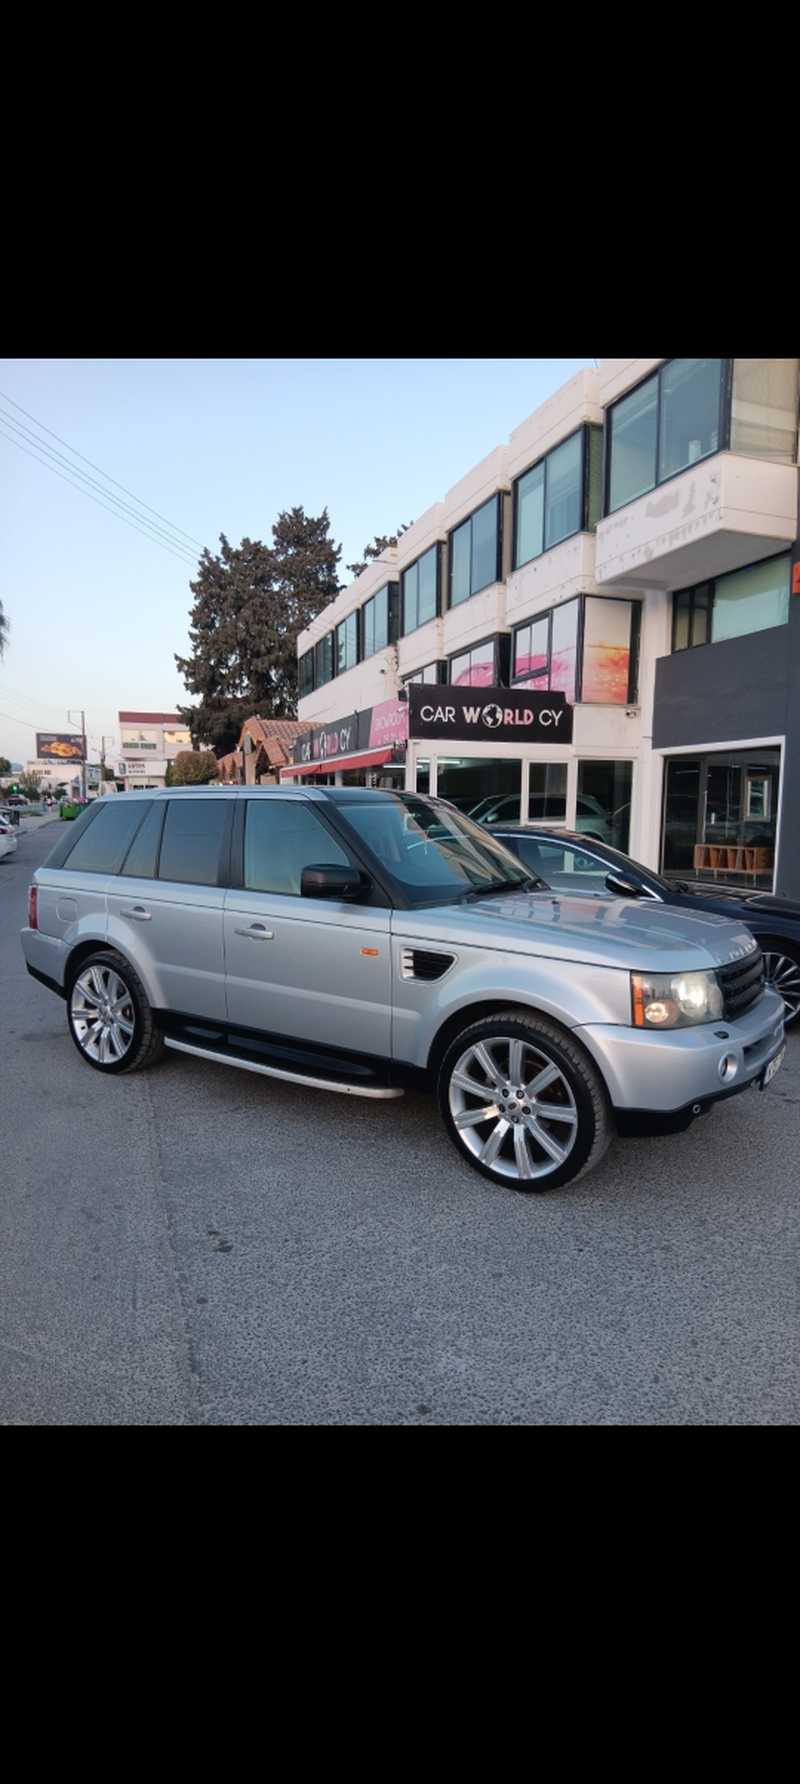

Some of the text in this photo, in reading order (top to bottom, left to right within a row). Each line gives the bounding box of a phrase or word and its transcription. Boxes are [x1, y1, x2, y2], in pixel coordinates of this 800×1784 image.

[420, 705, 456, 723] CAR
[463, 703, 534, 728] WORLD
[538, 709, 563, 727] CY
[340, 726, 351, 751] CY
